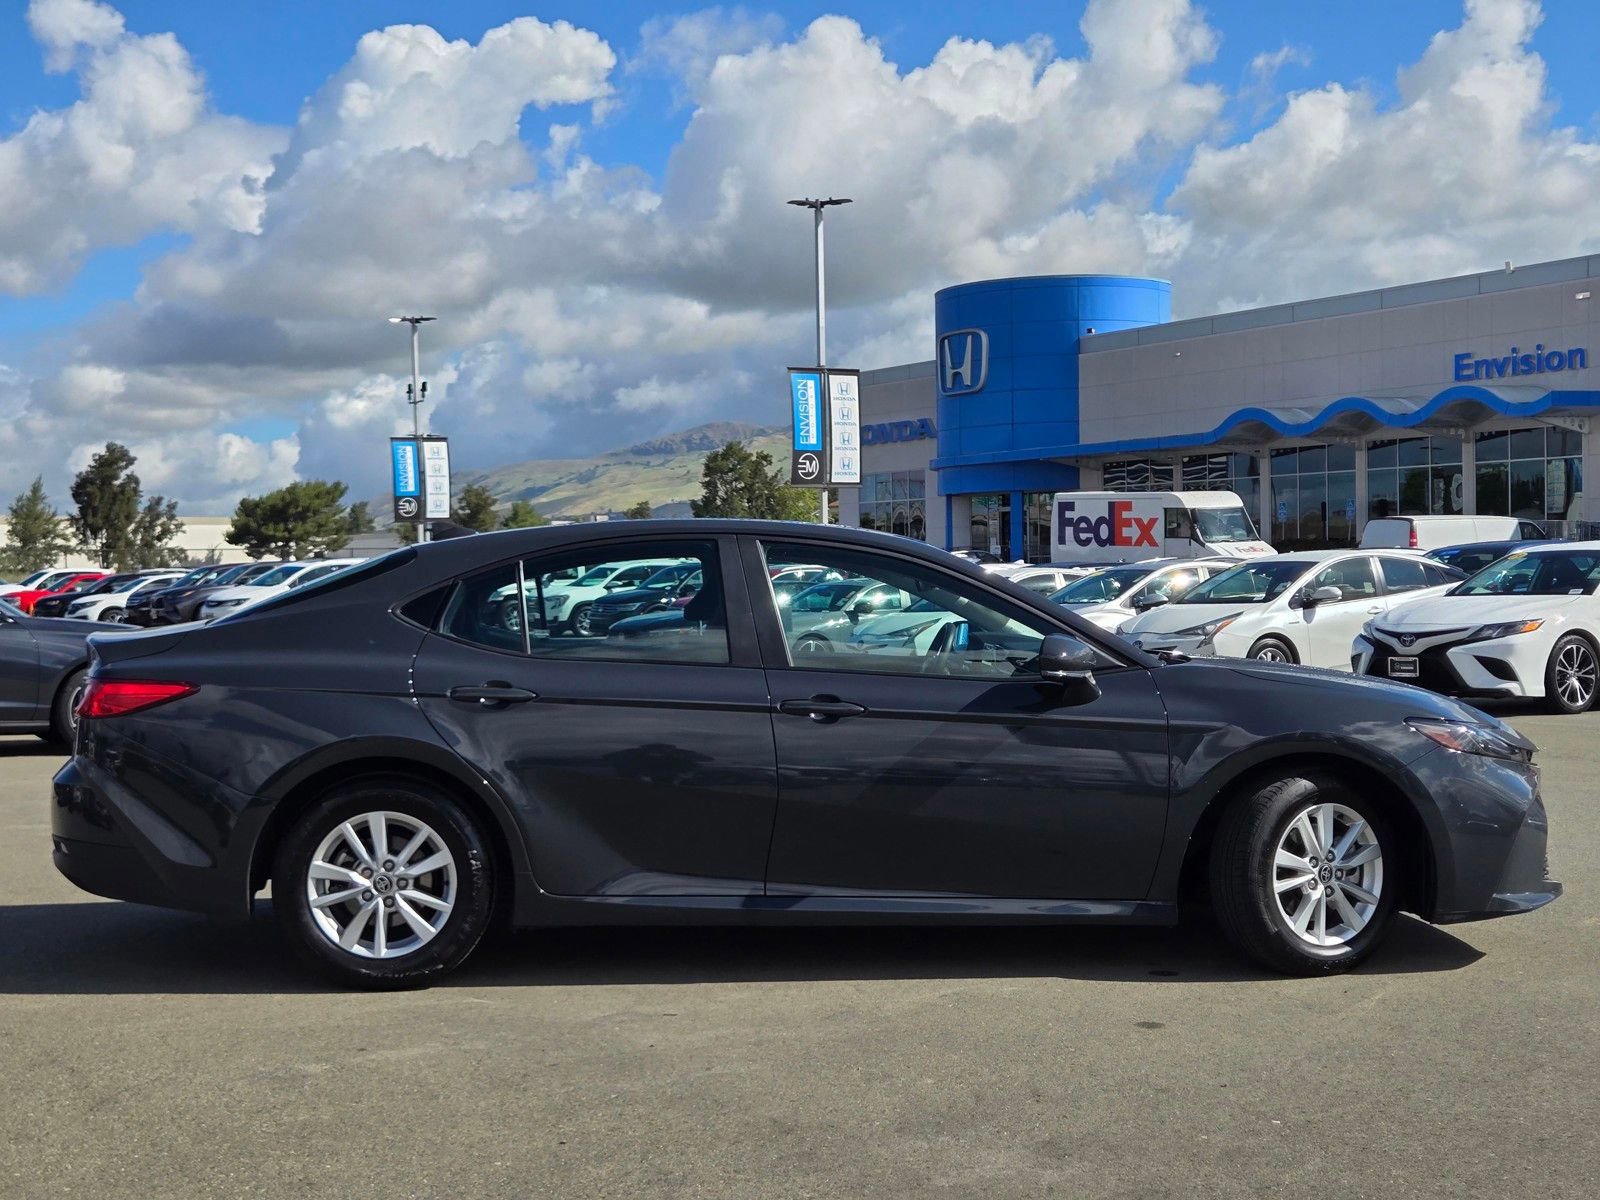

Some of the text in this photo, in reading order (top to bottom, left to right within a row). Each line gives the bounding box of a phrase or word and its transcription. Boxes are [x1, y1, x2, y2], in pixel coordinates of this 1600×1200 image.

[1454, 344, 1588, 381] Envision
[797, 379, 810, 445] ENVISION
[861, 418, 937, 445] ONDA
[1058, 500, 1159, 548] FedEx
